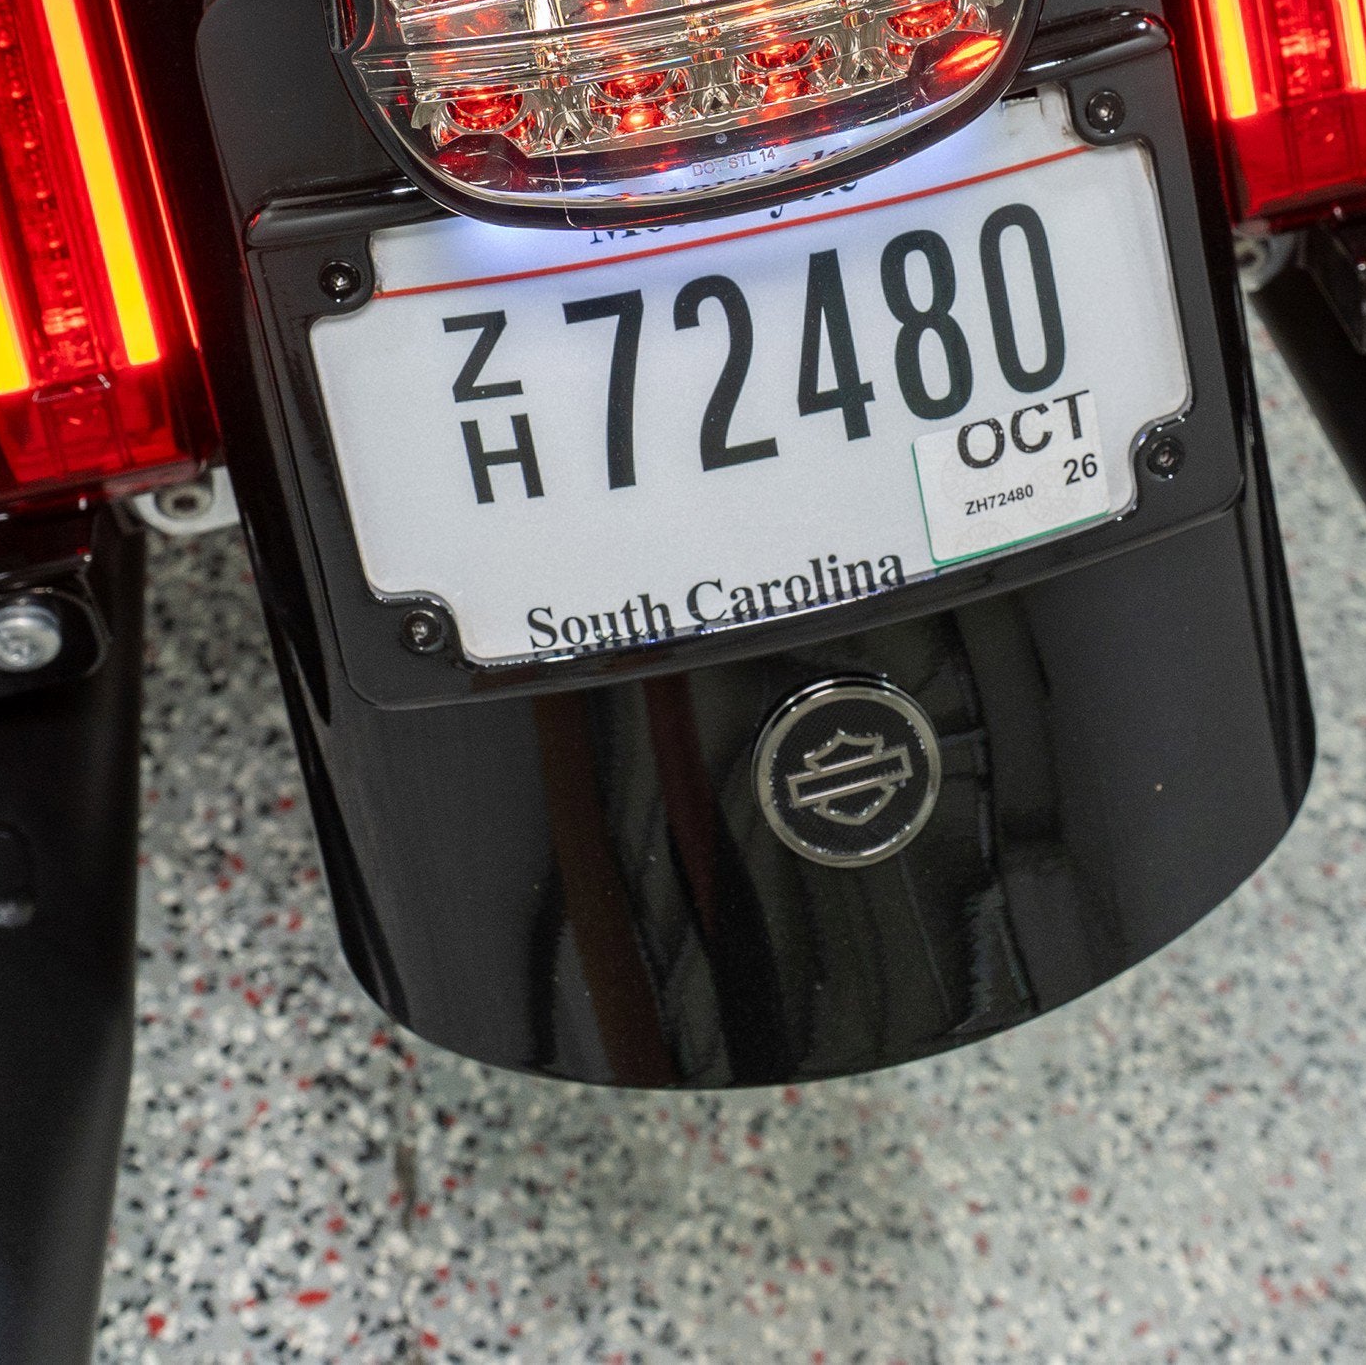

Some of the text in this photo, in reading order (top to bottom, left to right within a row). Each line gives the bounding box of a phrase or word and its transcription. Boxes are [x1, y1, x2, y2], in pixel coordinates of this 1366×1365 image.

[691, 147, 776, 177] DOT STL 14
[561, 203, 1066, 490] 72480
[957, 389, 1090, 469] OCT
[1063, 452, 1098, 486] 26
[965, 484, 1034, 516] ZH72480
[527, 553, 906, 650] South Carolina
